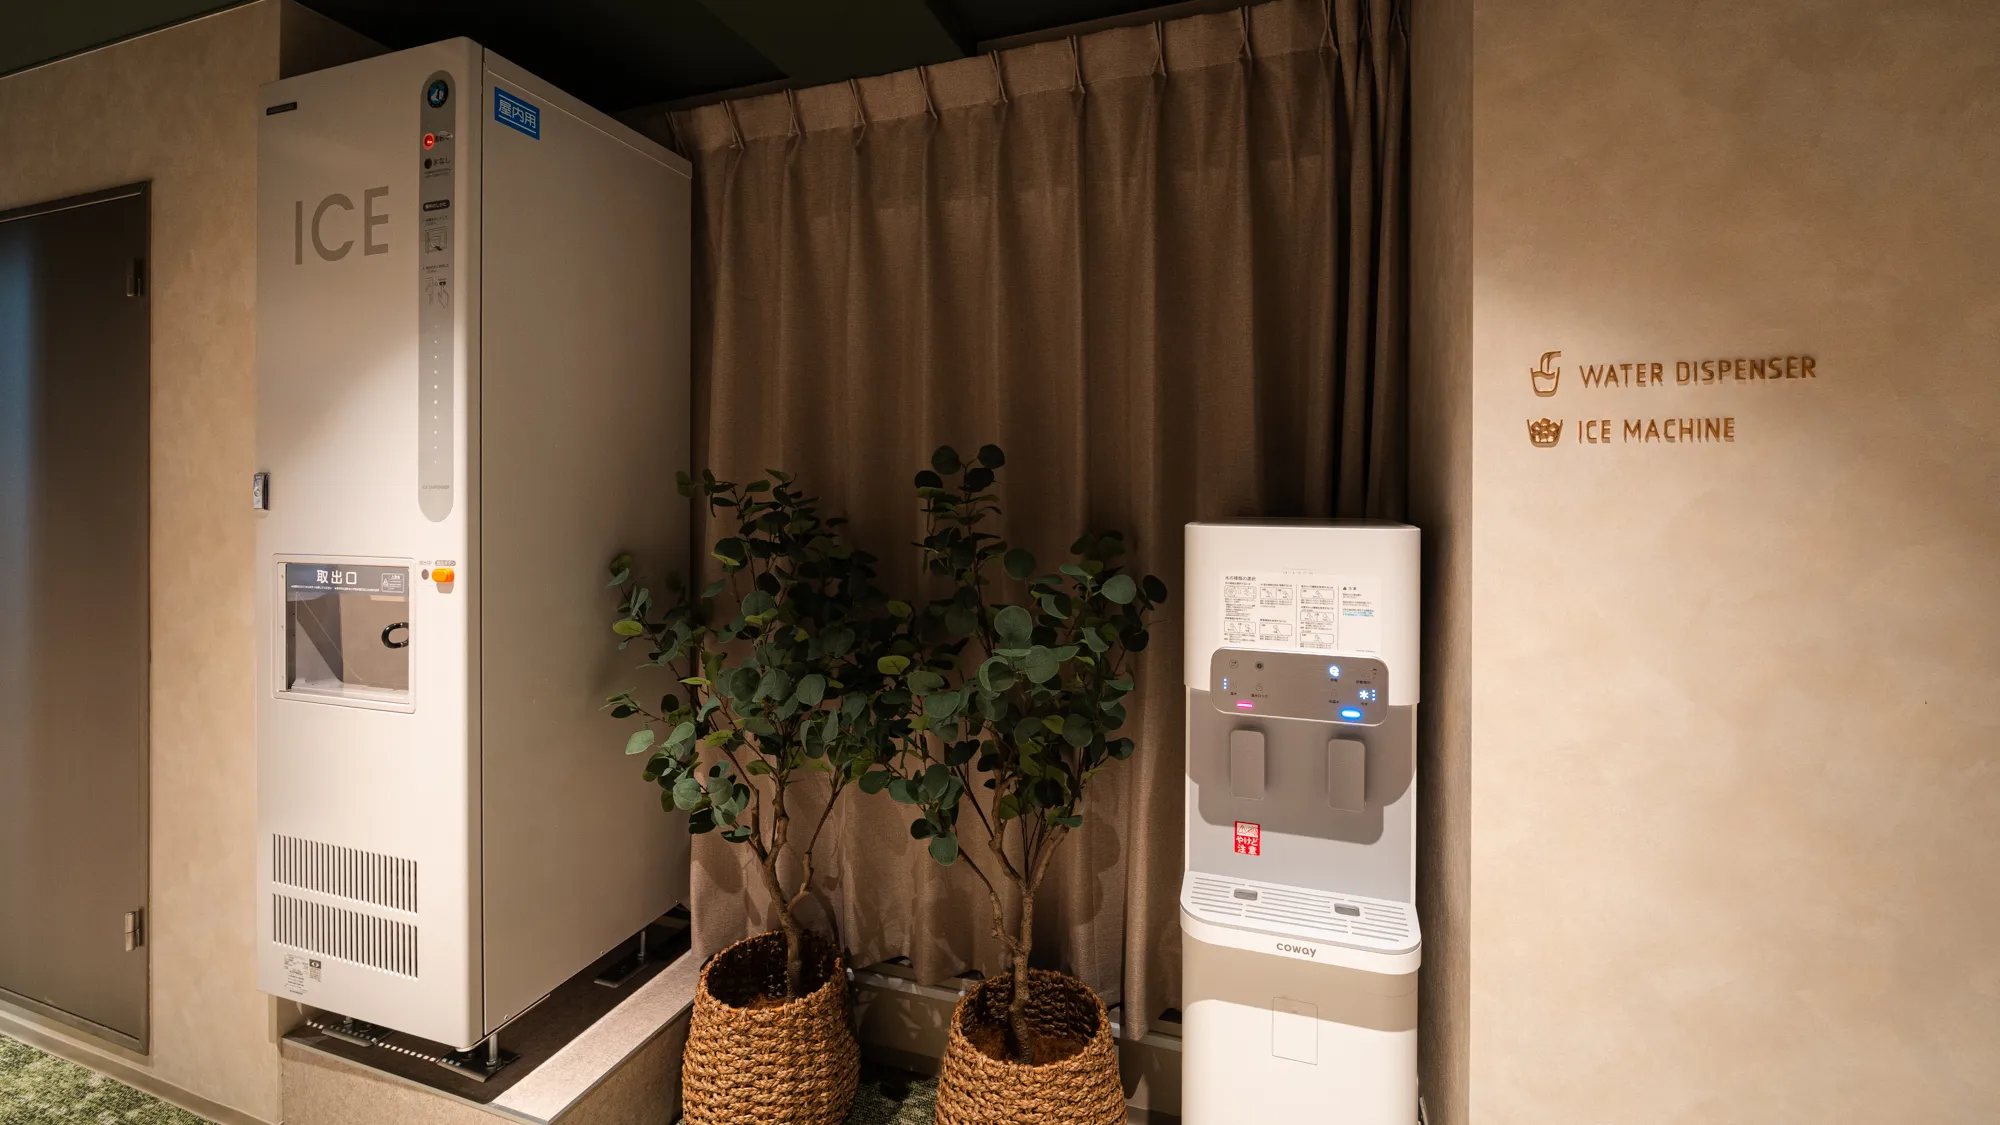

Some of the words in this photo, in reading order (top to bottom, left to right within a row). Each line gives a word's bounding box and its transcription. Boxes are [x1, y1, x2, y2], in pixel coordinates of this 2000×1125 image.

[498, 99, 536, 129] 屋内用
[294, 185, 389, 266] ICE
[1578, 362, 1664, 388] WATER
[1675, 356, 1817, 383] DISPENSER
[1578, 419, 1611, 443] ICE
[1623, 417, 1736, 443] MACHINE
[316, 569, 357, 585] 取出口
[1236, 836, 1258, 847] やけど
[1237, 844, 1257, 855] 注意
[1276, 942, 1317, 958] coway
